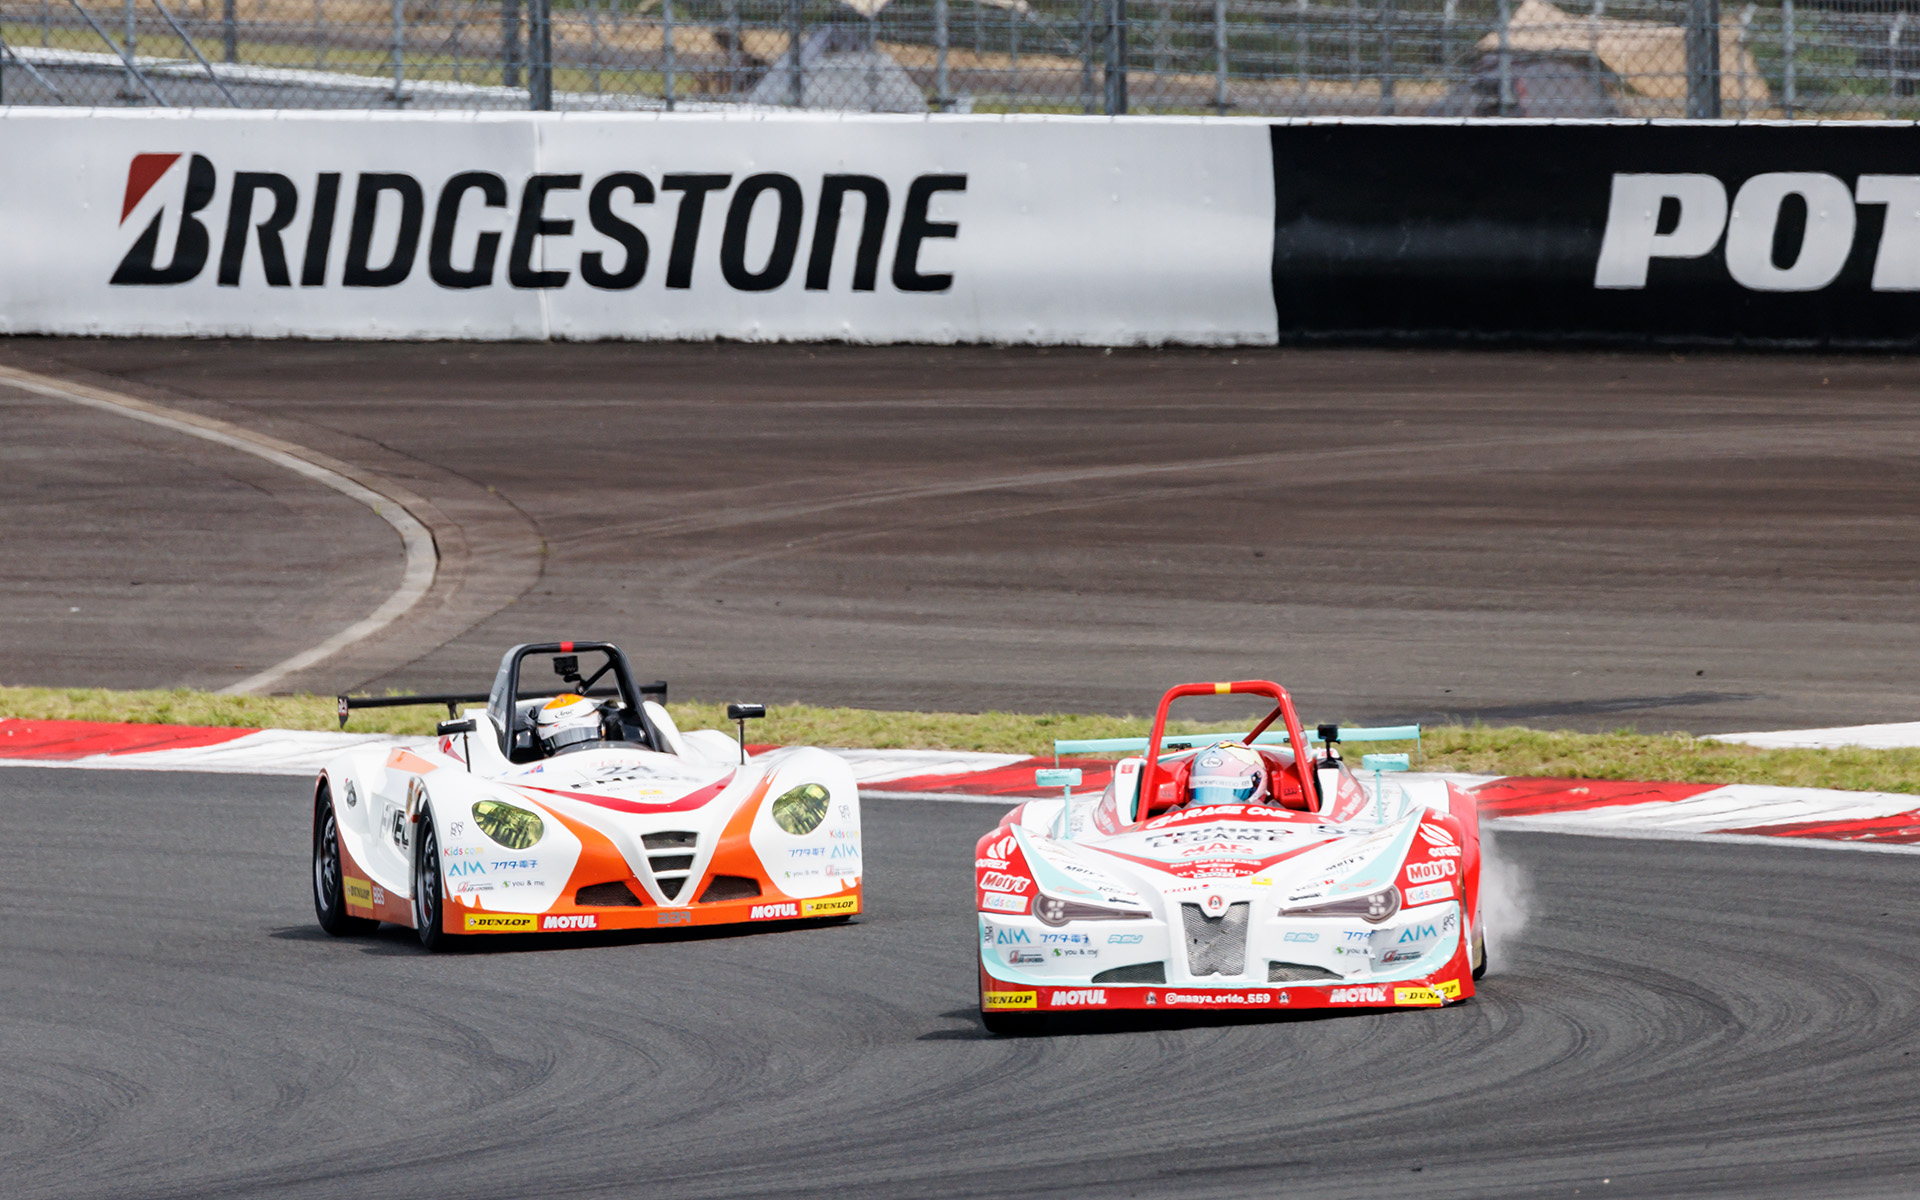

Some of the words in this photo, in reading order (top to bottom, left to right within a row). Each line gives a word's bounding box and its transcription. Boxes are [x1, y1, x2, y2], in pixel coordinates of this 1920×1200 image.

[110, 152, 968, 292] BRIDGESTONE
[1146, 805, 1246, 829] GARAGE
[1247, 807, 1295, 819] ONE
[449, 860, 486, 877] AIM
[1410, 861, 1454, 880] Moty's
[982, 873, 1028, 891] Moty's
[750, 903, 798, 919] MOTUL
[815, 901, 854, 910] DUNLOP
[477, 918, 531, 926] DUNLOP
[543, 915, 597, 929] MOTUL
[997, 928, 1031, 944] AIM
[1398, 924, 1437, 943] AIM
[1051, 990, 1107, 1006] MOTUL
[1330, 987, 1386, 1004] MOTUL
